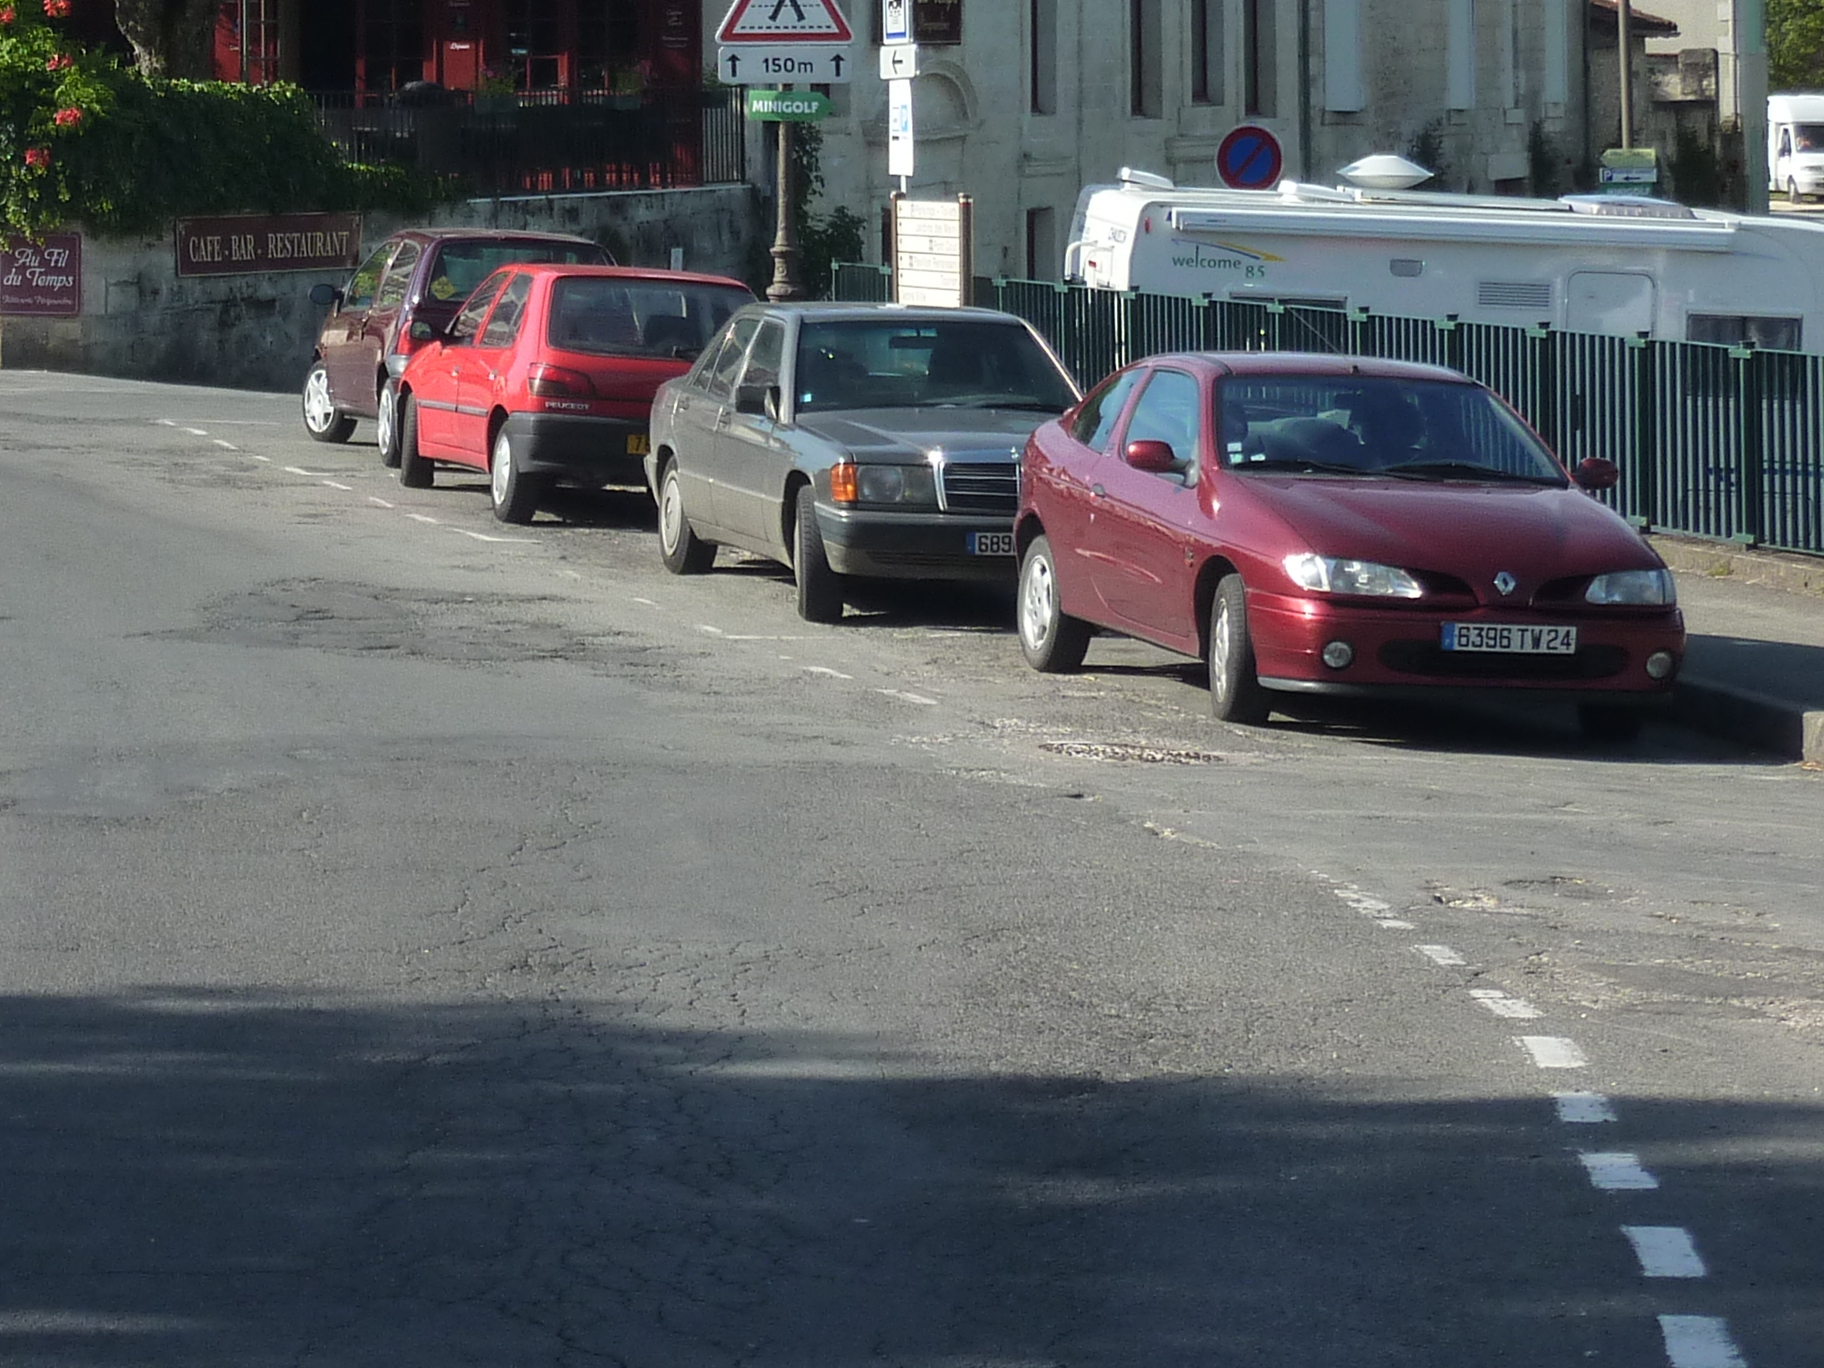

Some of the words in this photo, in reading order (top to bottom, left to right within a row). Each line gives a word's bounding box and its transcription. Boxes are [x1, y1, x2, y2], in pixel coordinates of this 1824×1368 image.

[752, 100, 820, 114] MINIGOLF
[14, 247, 40, 267] Au
[44, 247, 70, 268] Fil
[189, 235, 223, 262] CAFE
[230, 234, 256, 261] BAR
[267, 231, 350, 259] RESTAURANT
[1172, 245, 1242, 269] welcome
[3, 267, 22, 286] du
[25, 267, 74, 292] Temps
[1244, 264, 1265, 279] 85
[544, 400, 590, 410] PEUGEOT
[1457, 626, 1512, 650] 6396
[1517, 628, 1543, 650] TW
[1546, 629, 1572, 651] 24
